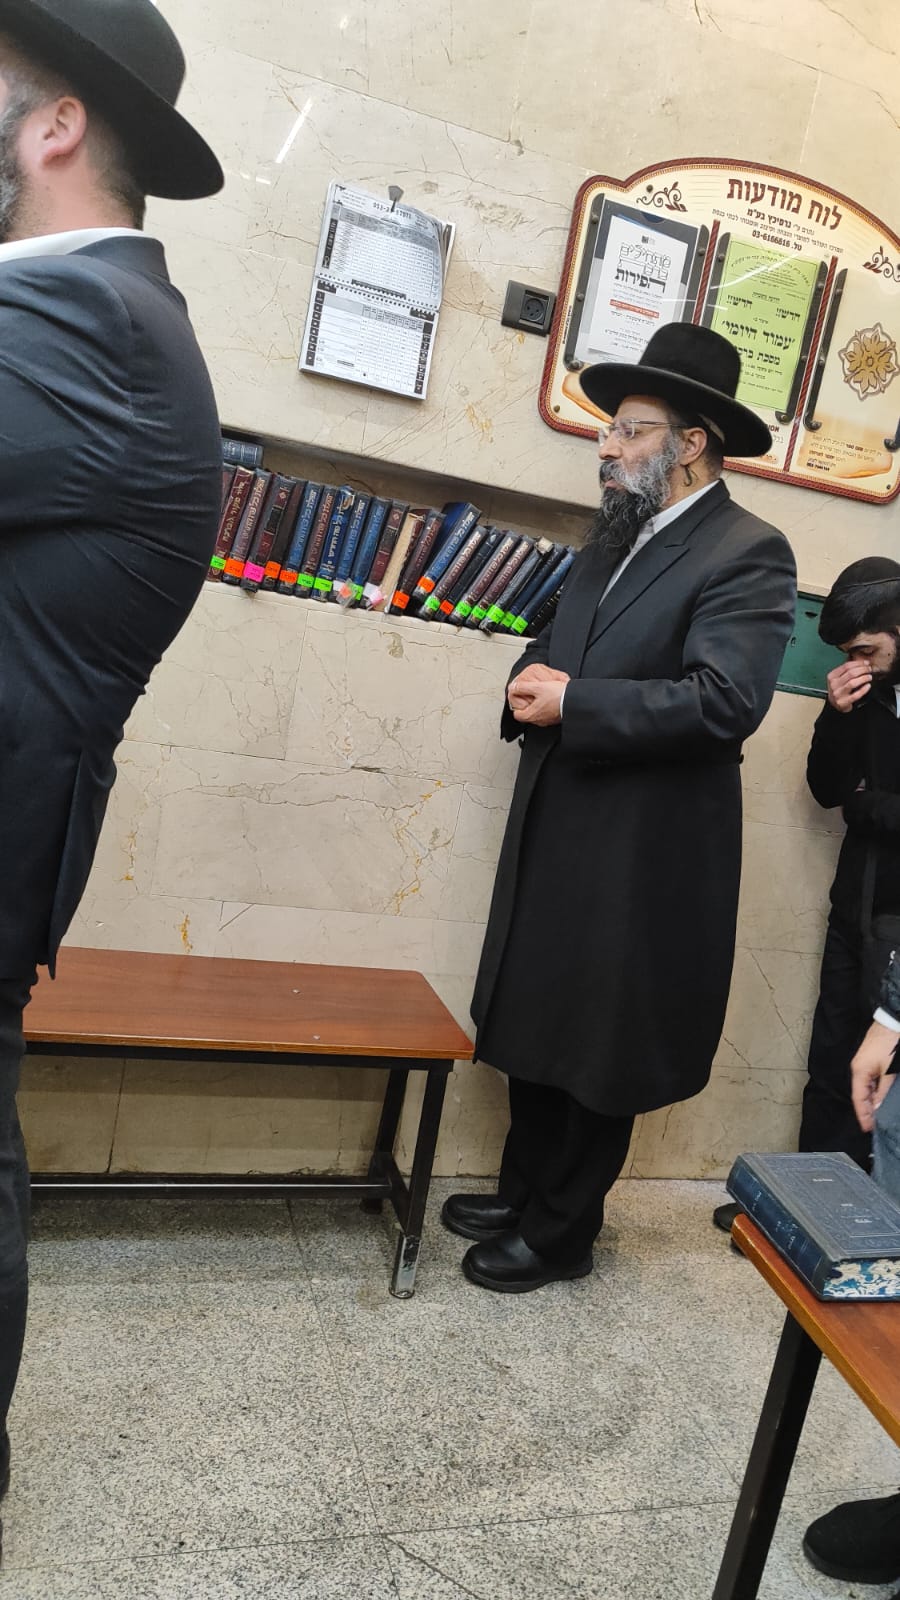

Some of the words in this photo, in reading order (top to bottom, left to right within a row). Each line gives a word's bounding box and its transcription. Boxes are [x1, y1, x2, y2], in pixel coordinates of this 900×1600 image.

[727, 178, 803, 214] מודעות
[747, 208, 765, 220] בע"מ
[808, 199, 842, 230] לוח
[620, 243, 671, 268] מתחילים
[615, 268, 666, 293] הפירות
[757, 352, 780, 366] מסכת
